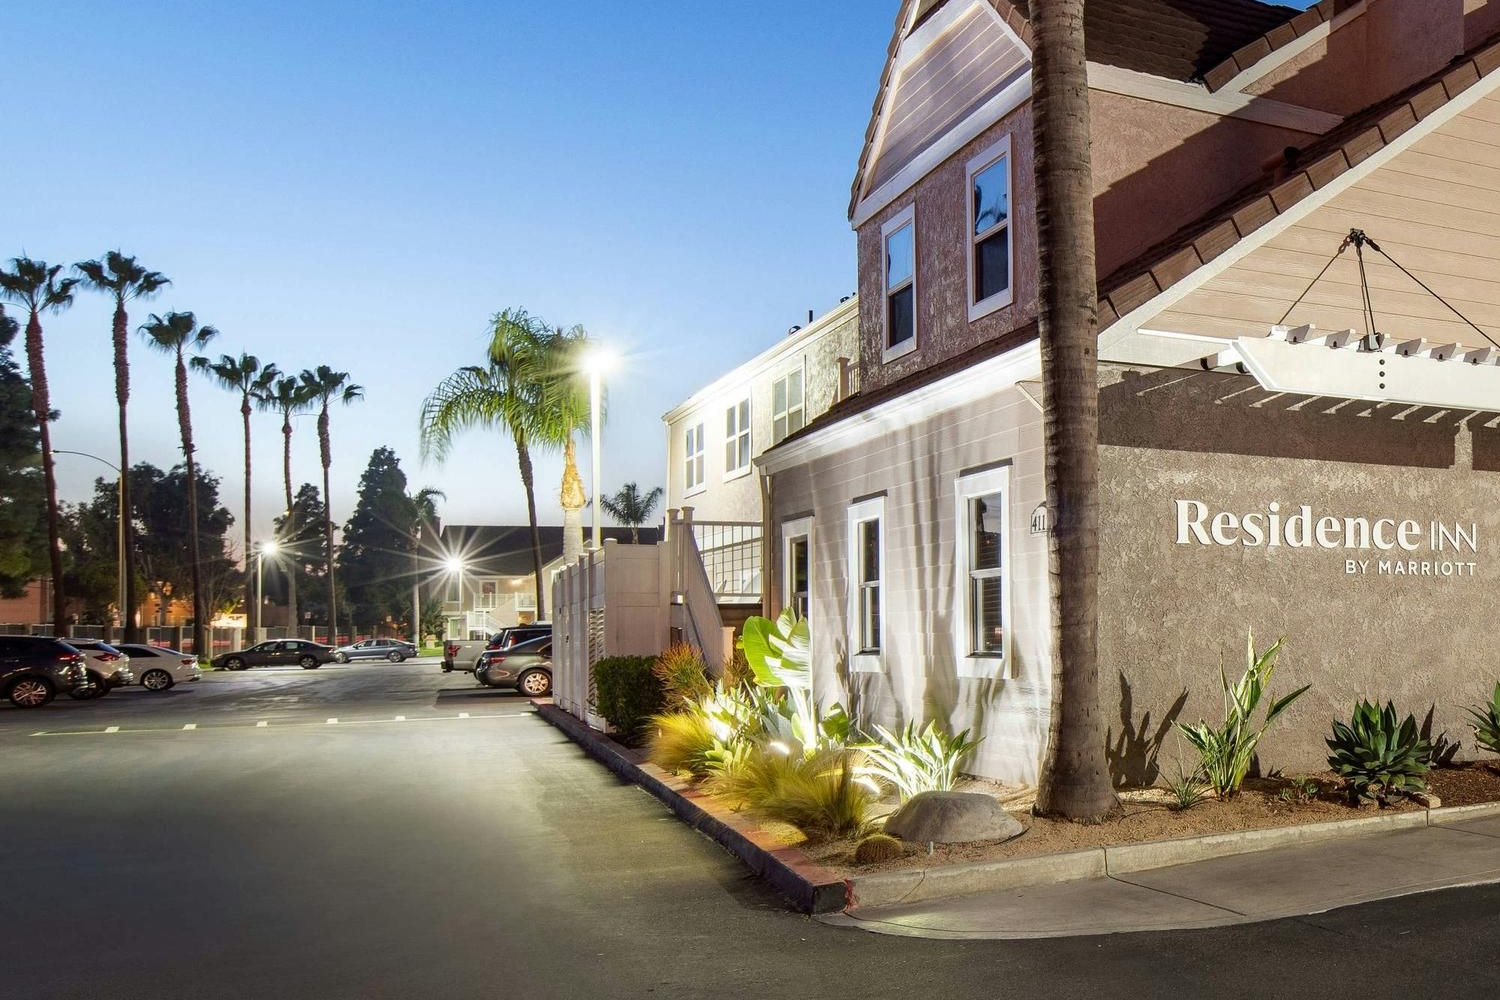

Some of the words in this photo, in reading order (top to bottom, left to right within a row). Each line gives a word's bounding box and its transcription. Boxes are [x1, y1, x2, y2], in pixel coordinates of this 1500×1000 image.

[1175, 500, 1421, 551] Residence
[1430, 520, 1477, 553] INN
[1345, 560, 1369, 574] BY
[1378, 560, 1477, 577] MARRIOTT
